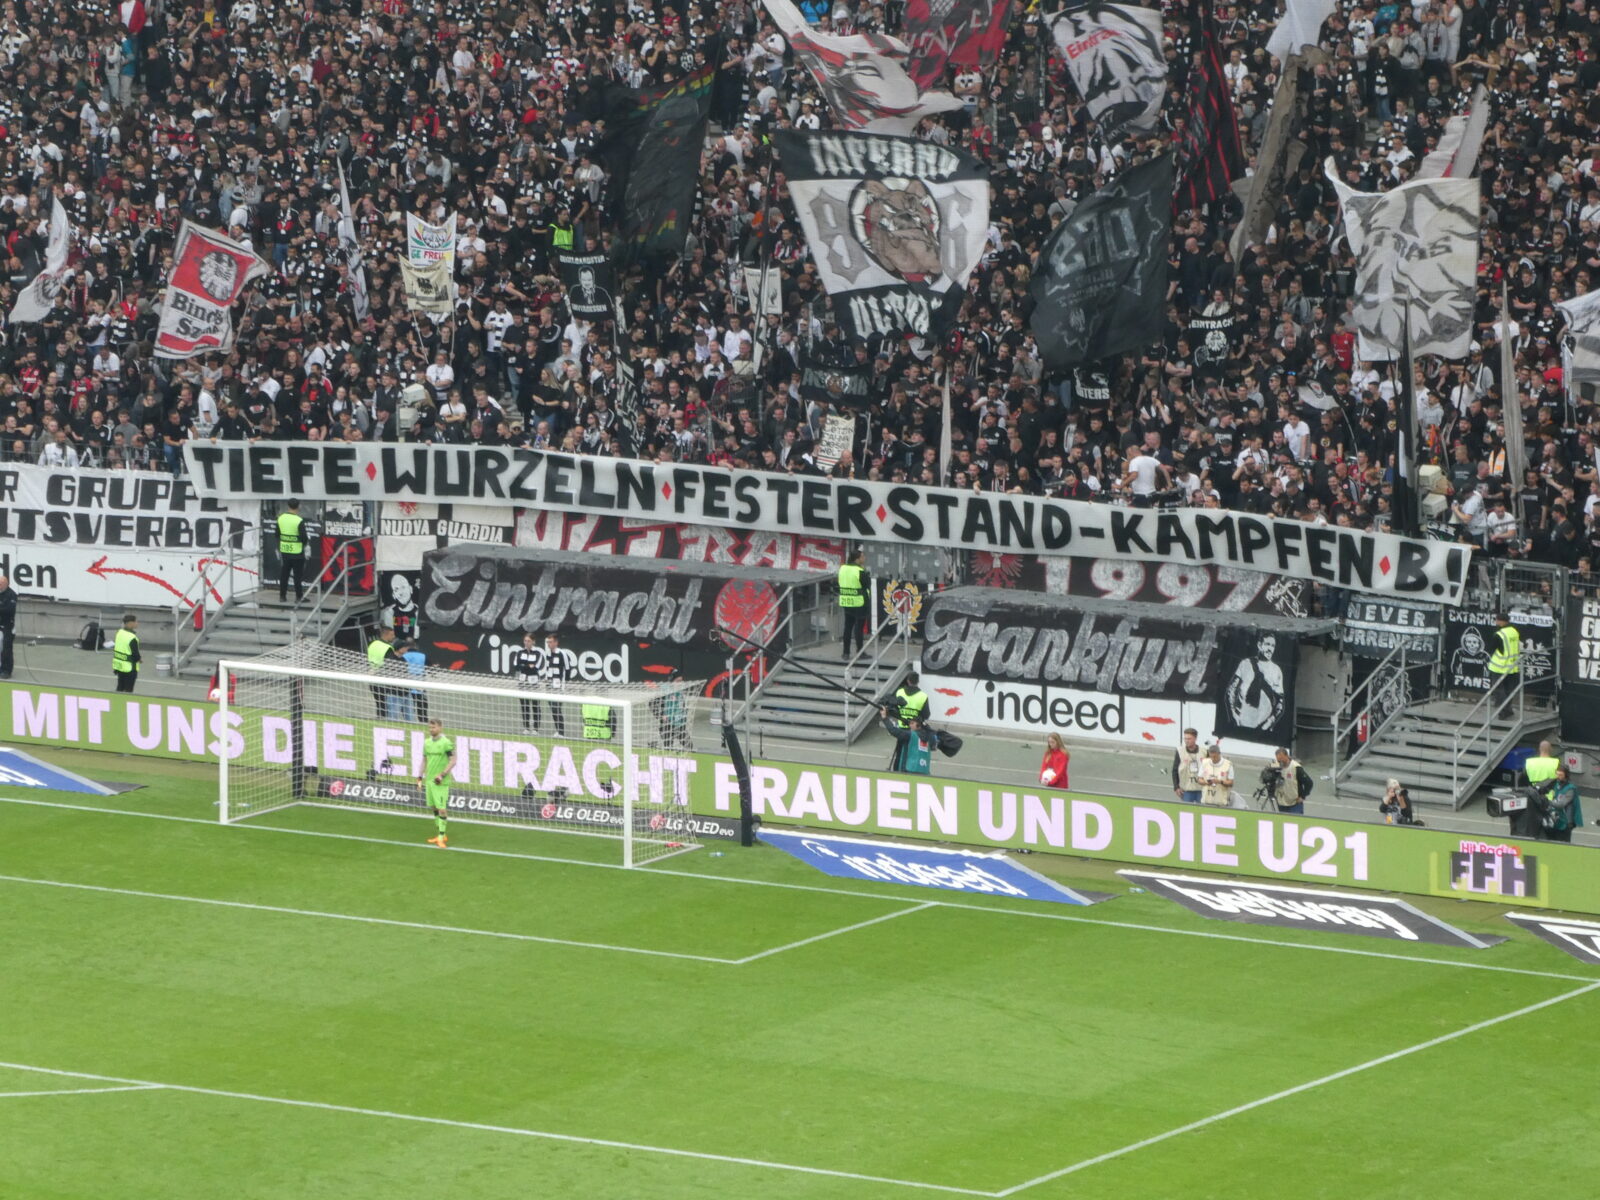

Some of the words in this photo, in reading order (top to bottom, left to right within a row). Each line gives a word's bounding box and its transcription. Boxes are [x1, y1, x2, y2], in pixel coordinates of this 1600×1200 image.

[192, 447, 360, 495] TIEFE
[381, 447, 656, 512] WURZELN
[673, 467, 875, 536] FESTER
[1395, 540, 1463, 598] B.!
[380, 518, 430, 536] NUOVA
[436, 519, 503, 543] GUARDIA
[1037, 554, 1272, 612] 1997
[424, 553, 703, 643] Eintracht
[1347, 601, 1426, 627] NEVER
[1448, 609, 1497, 626] EXTREME
[922, 600, 1219, 694] Frankfurt
[1454, 675, 1491, 689] FANS
[985, 680, 1125, 735] indeed
[12, 690, 110, 744] MIT
[126, 701, 246, 760] UNS
[262, 716, 357, 771] DIE
[714, 762, 958, 836] FRAUEN
[977, 789, 1114, 851] UND
[1133, 806, 1239, 867] DIE
[1258, 820, 1369, 881] U21
[344, 783, 361, 797] LG
[1207, 789, 1217, 797] TV
[449, 795, 466, 808] LG
[556, 807, 574, 820] LG
[666, 818, 683, 831] LG
